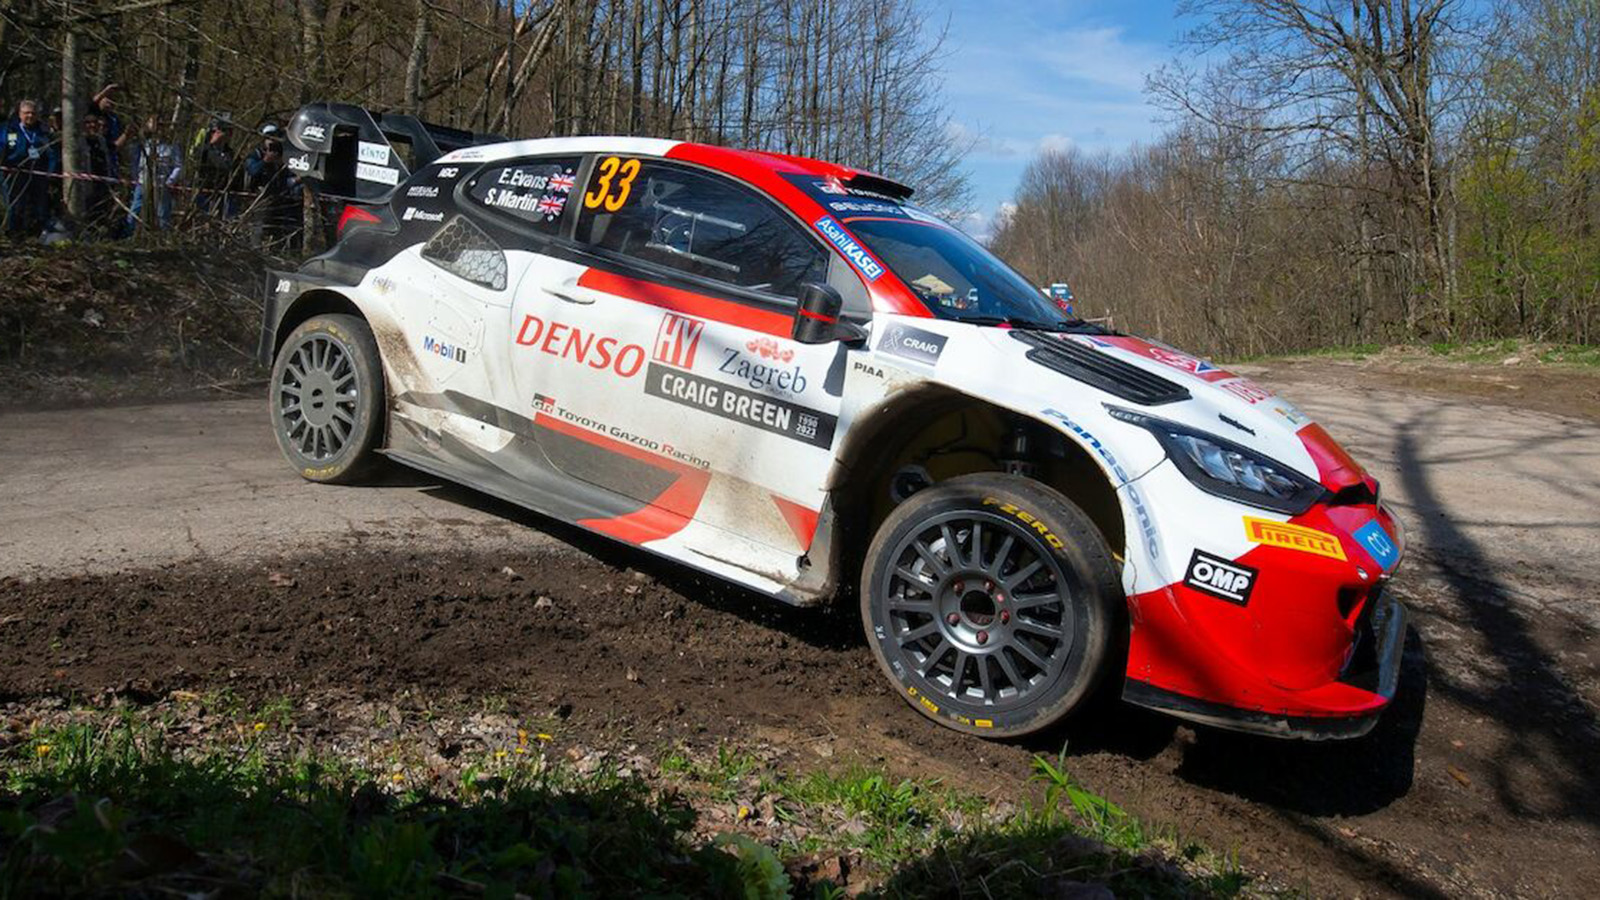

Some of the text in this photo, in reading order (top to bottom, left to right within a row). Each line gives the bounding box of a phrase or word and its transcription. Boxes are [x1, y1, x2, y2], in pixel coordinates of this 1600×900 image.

[498, 168, 549, 190] E.Evans
[585, 155, 641, 212] 33
[484, 188, 539, 212] S.Martin
[423, 335, 455, 360] Mobil
[516, 314, 646, 378] DENSO
[903, 337, 939, 354] CRAIG
[718, 347, 807, 394] Zagreb
[853, 361, 884, 378] PIAA
[660, 373, 792, 430] CRAIG BREEN
[557, 406, 606, 433] TOYOTA
[610, 427, 659, 450] GAZOO
[661, 443, 711, 468] Racing
[1041, 408, 1159, 560] Panasonic
[1000, 503, 1064, 549] ZERO
[1251, 521, 1338, 554] PIRELLI
[1192, 562, 1249, 593] OMP
